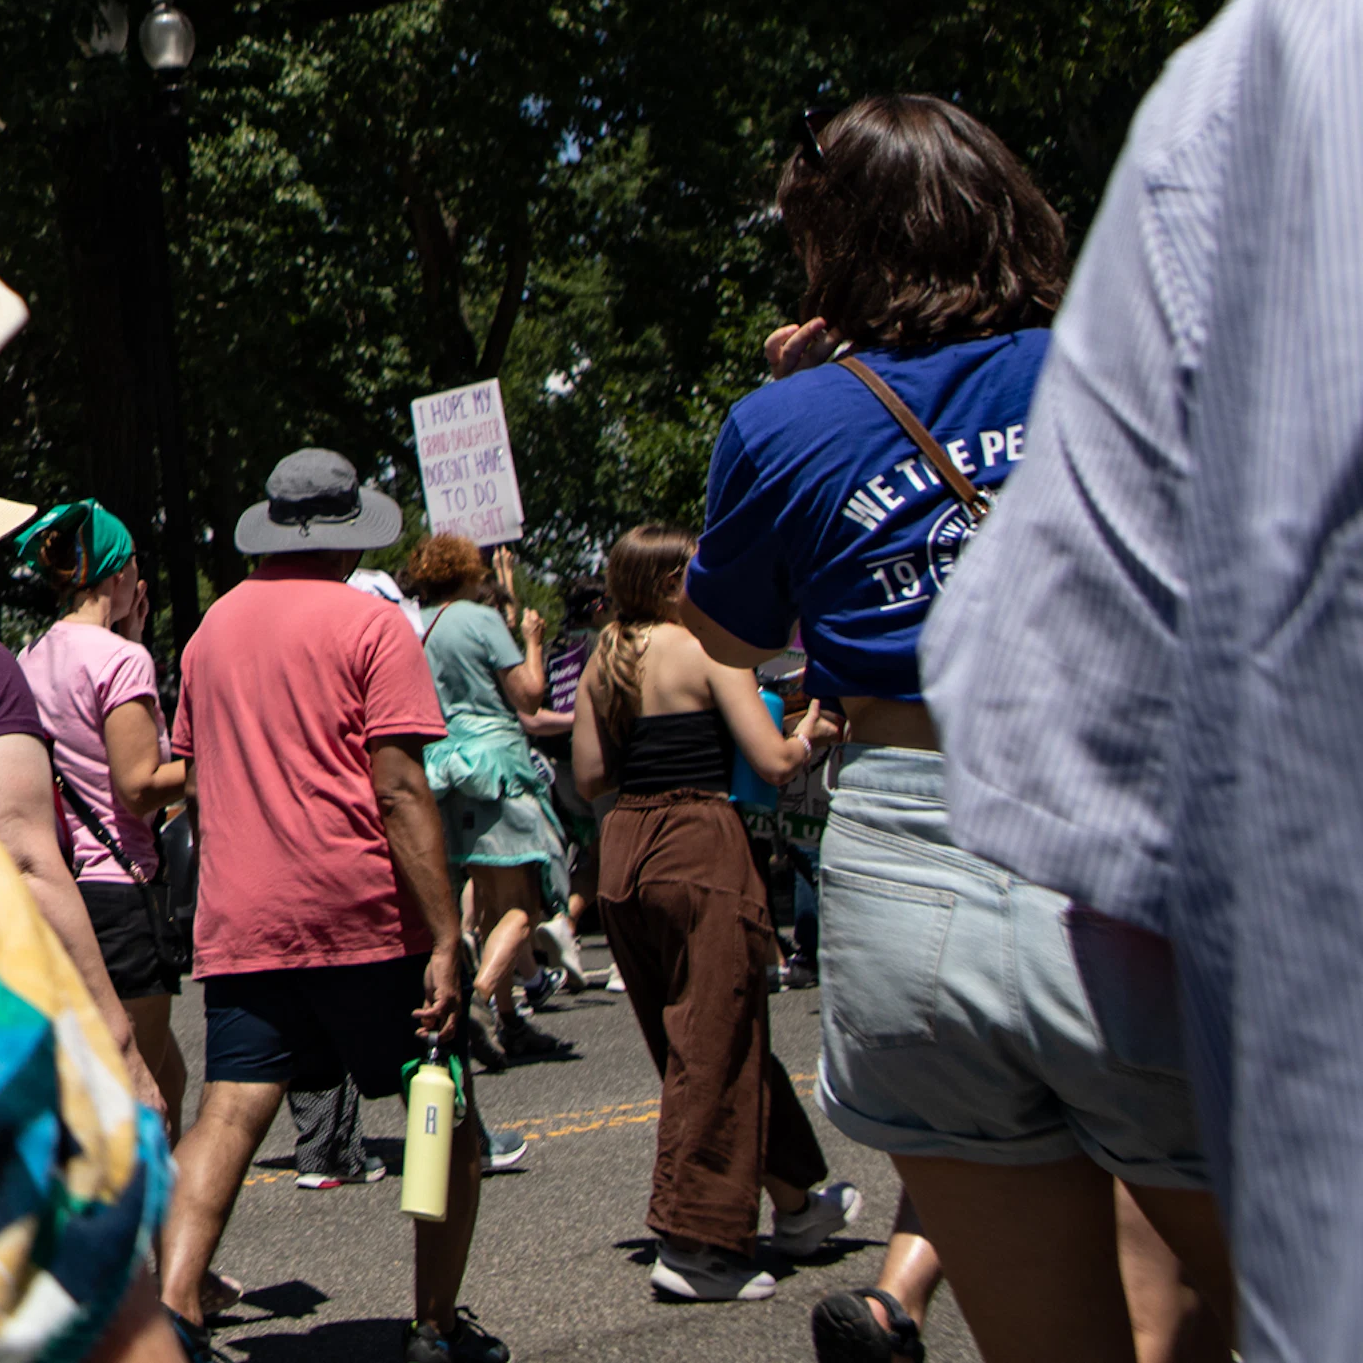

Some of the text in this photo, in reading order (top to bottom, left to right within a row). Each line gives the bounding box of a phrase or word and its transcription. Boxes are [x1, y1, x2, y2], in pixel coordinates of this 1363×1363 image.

[417, 386, 492, 430] I HOPE MY
[474, 445, 507, 477] HAVE
[440, 479, 497, 513] TO DO
[841, 475, 906, 531] WE
[470, 506, 506, 539] SHIT
